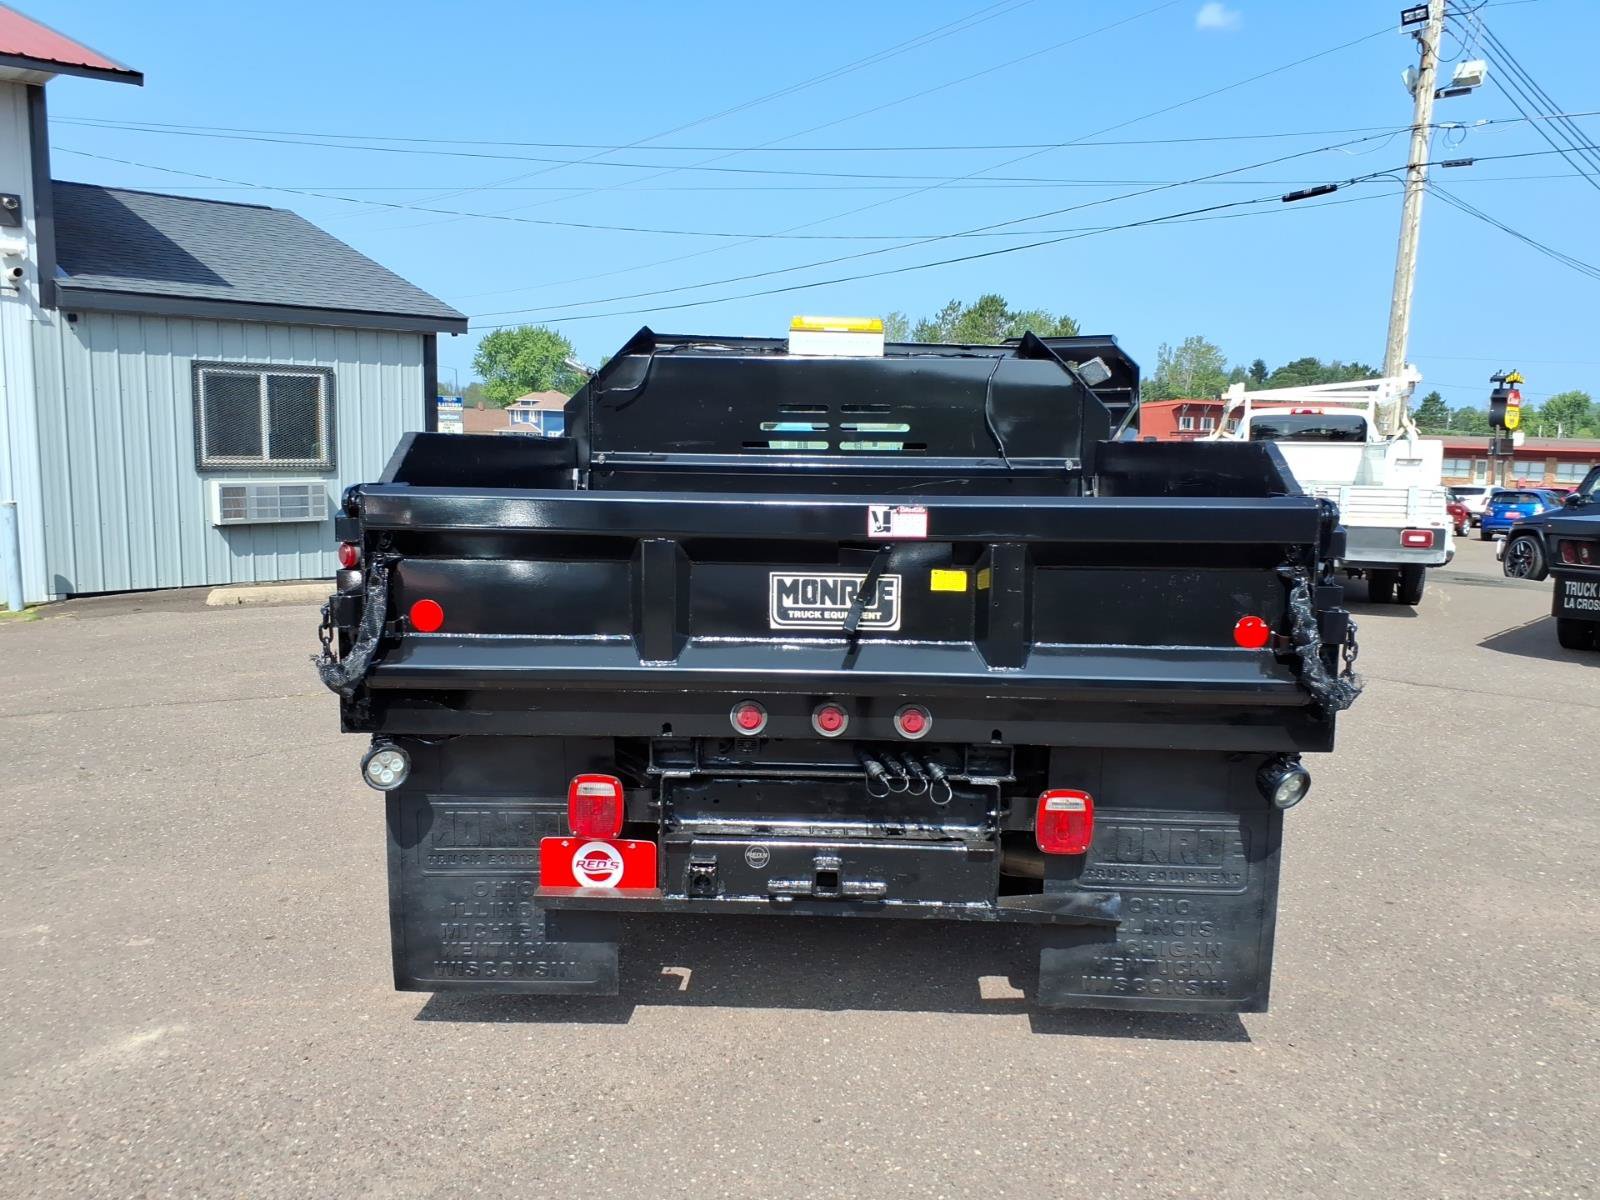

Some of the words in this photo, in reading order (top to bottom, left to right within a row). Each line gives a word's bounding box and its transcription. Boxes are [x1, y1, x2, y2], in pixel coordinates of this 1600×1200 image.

[1565, 581, 1597, 597] TRUCK
[1564, 597, 1574, 608] LA
[1577, 598, 1600, 610] CROS
[787, 610, 822, 619] TRUCK
[824, 611, 882, 620] EQUIENT
[427, 854, 481, 865] TRUCK
[472, 880, 535, 898] OHIO
[1128, 897, 1191, 915] OHIO
